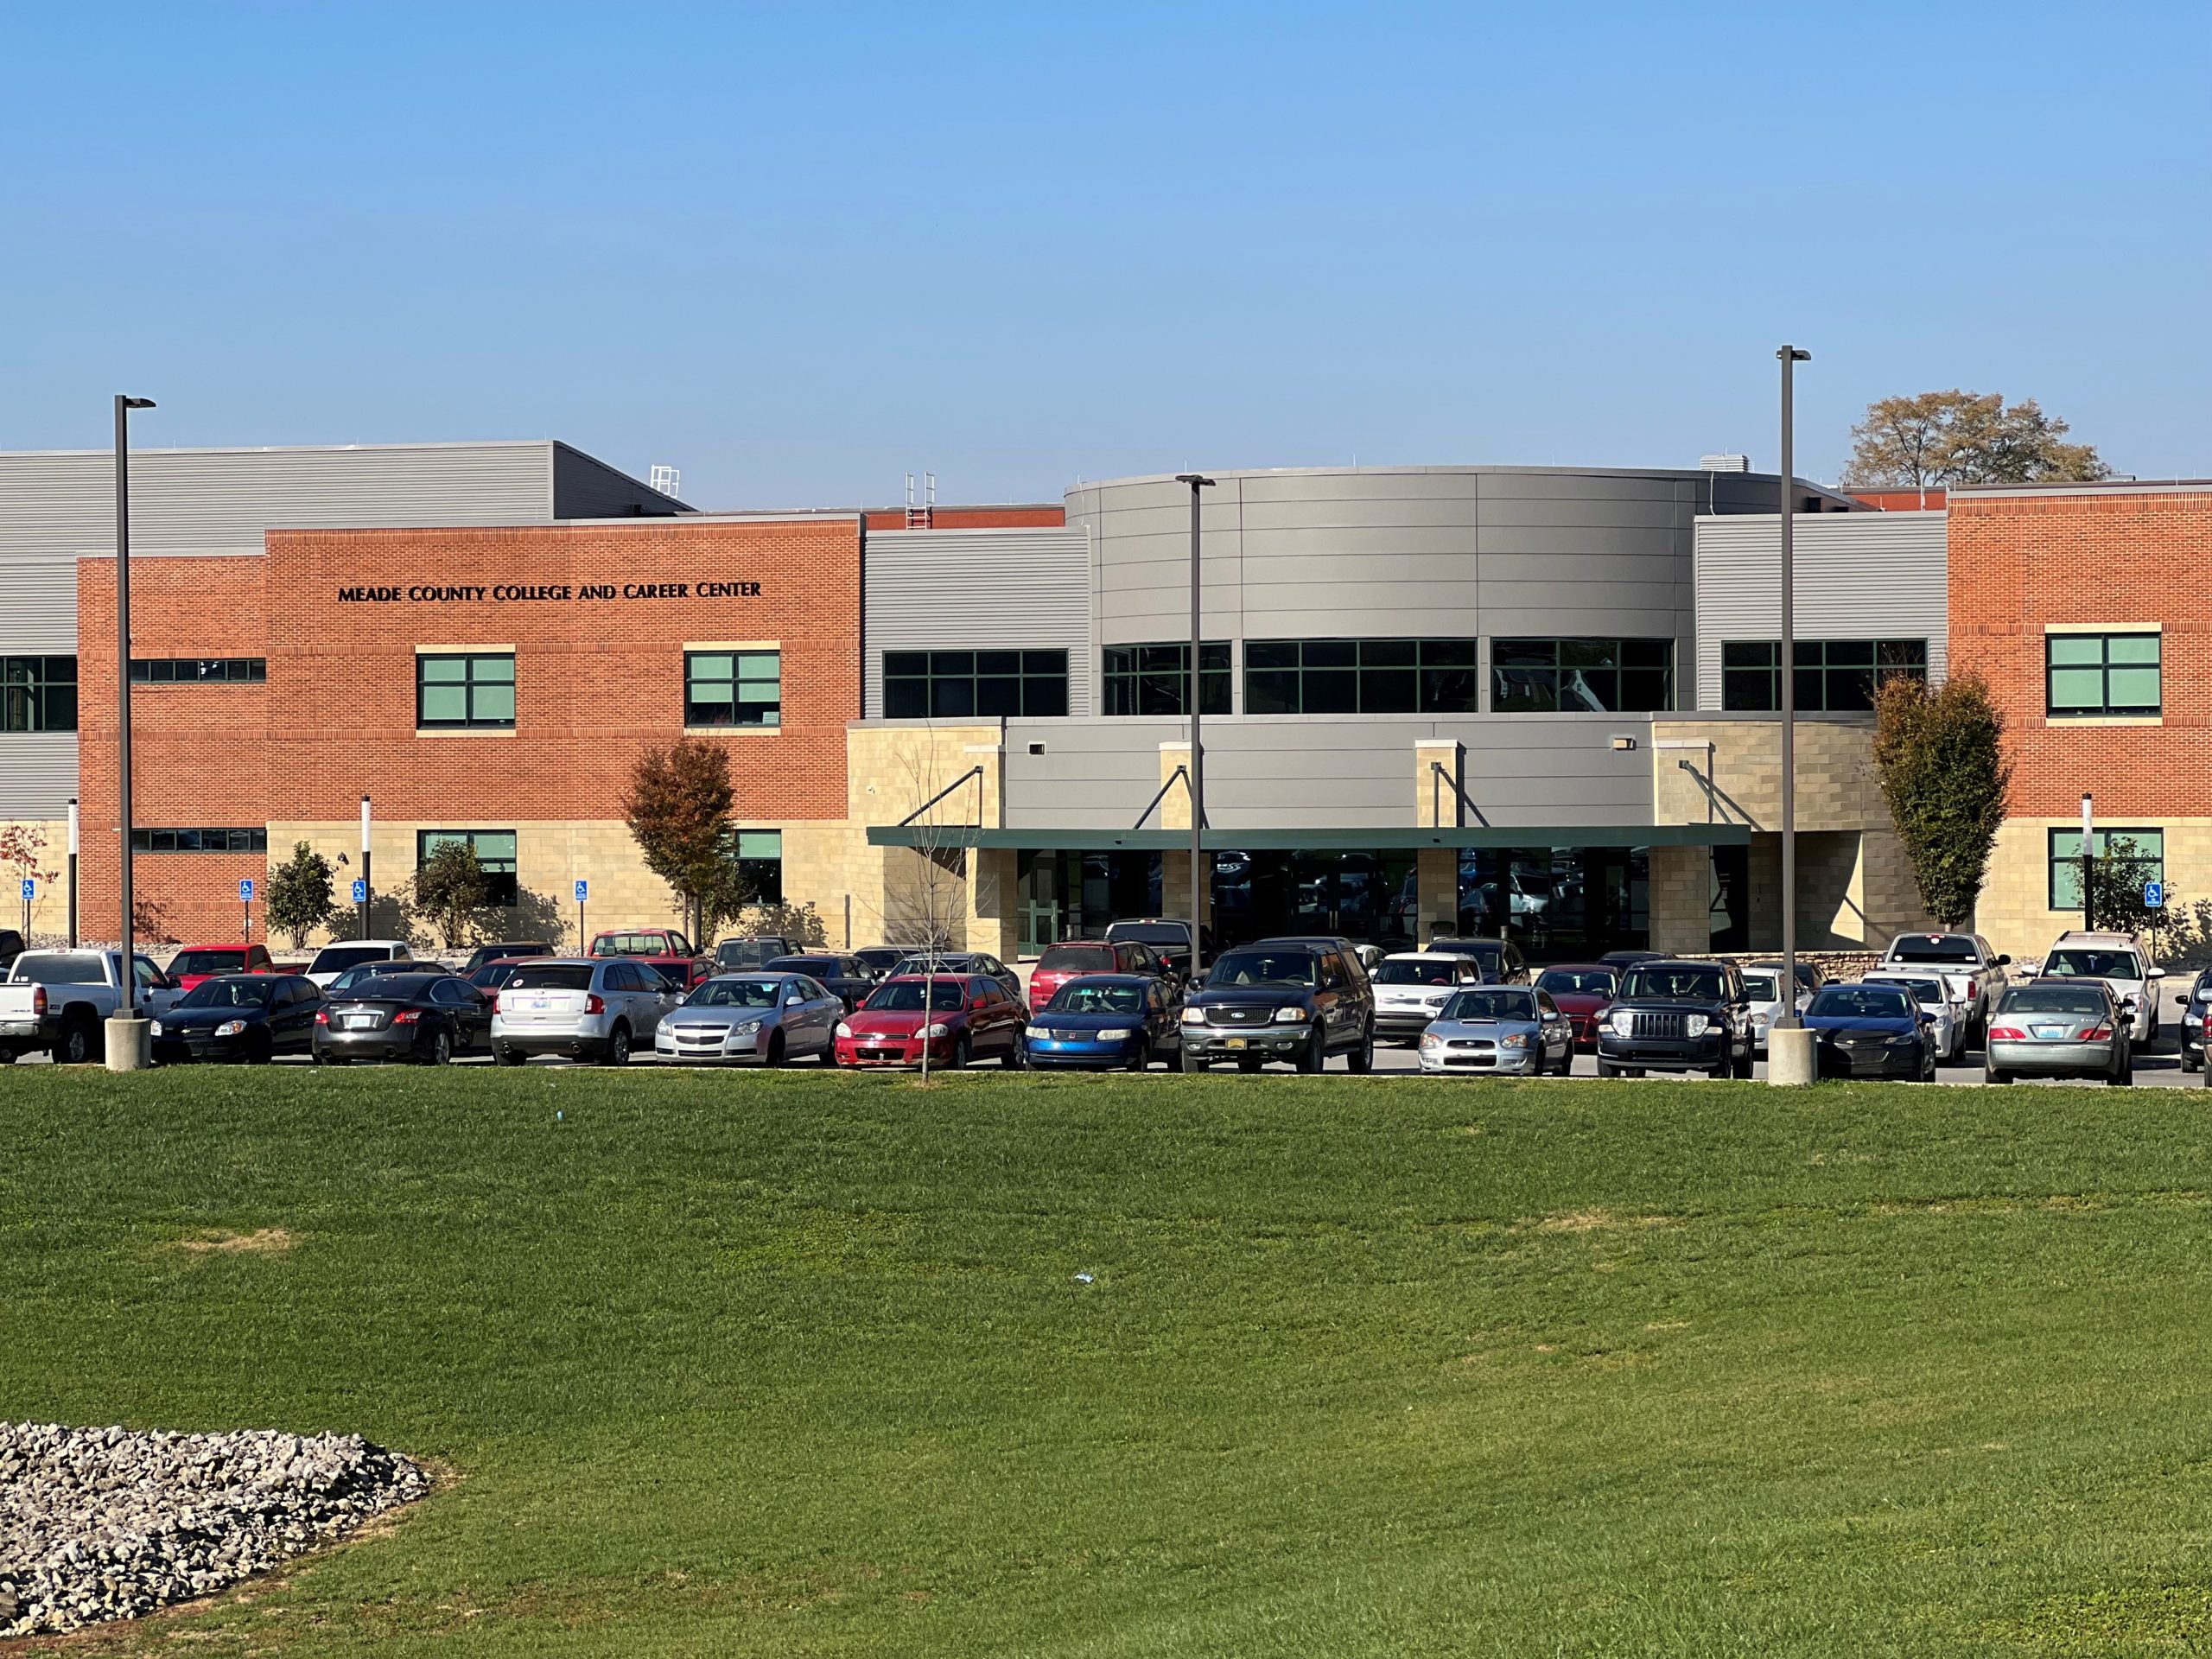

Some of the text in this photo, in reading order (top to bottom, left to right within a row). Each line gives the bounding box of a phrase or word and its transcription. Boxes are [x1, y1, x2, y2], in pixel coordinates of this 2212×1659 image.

[338, 582, 762, 602] MEADE COUNTY COLLEGE AND CAREER CENTER
